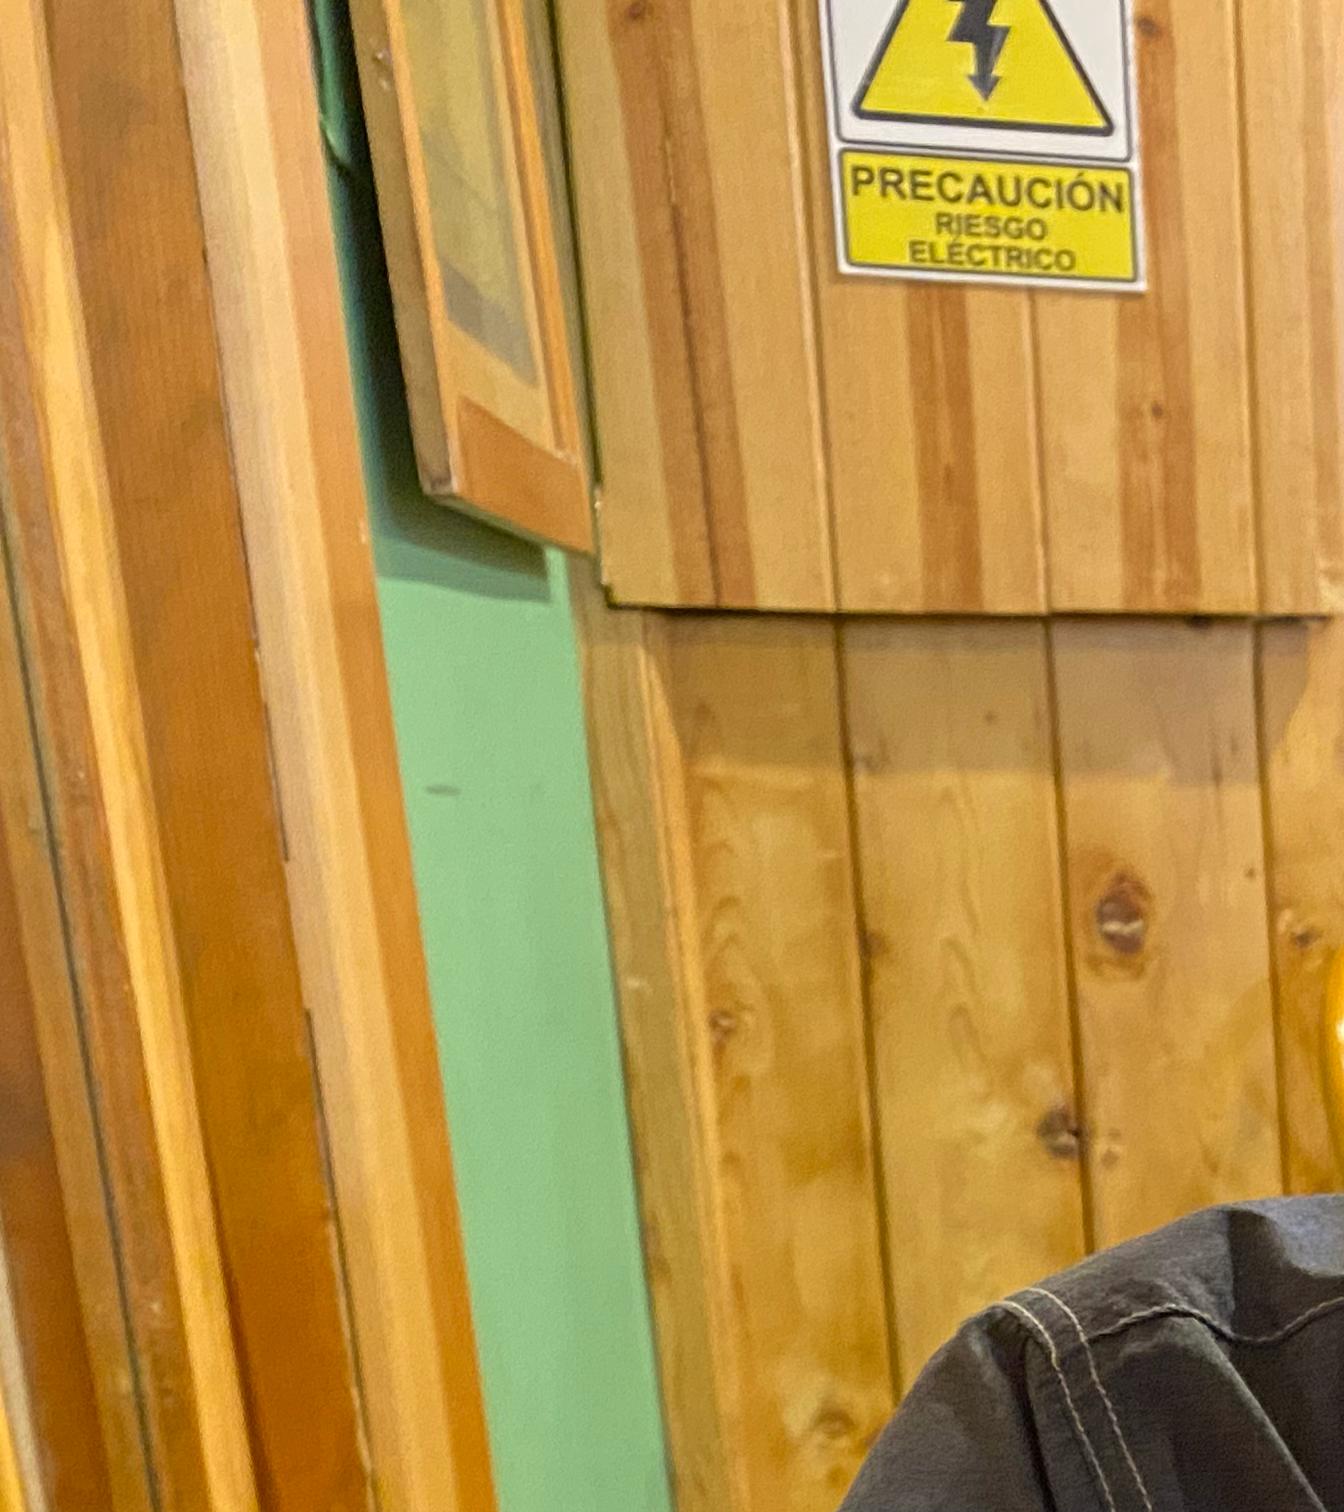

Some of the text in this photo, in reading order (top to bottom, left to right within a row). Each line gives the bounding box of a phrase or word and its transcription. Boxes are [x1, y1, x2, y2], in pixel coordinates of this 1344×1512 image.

[850, 164, 1124, 214] PRECAUCIÓN
[935, 211, 1048, 241] RIESGO
[908, 234, 1077, 272] ELÉCTRICO
